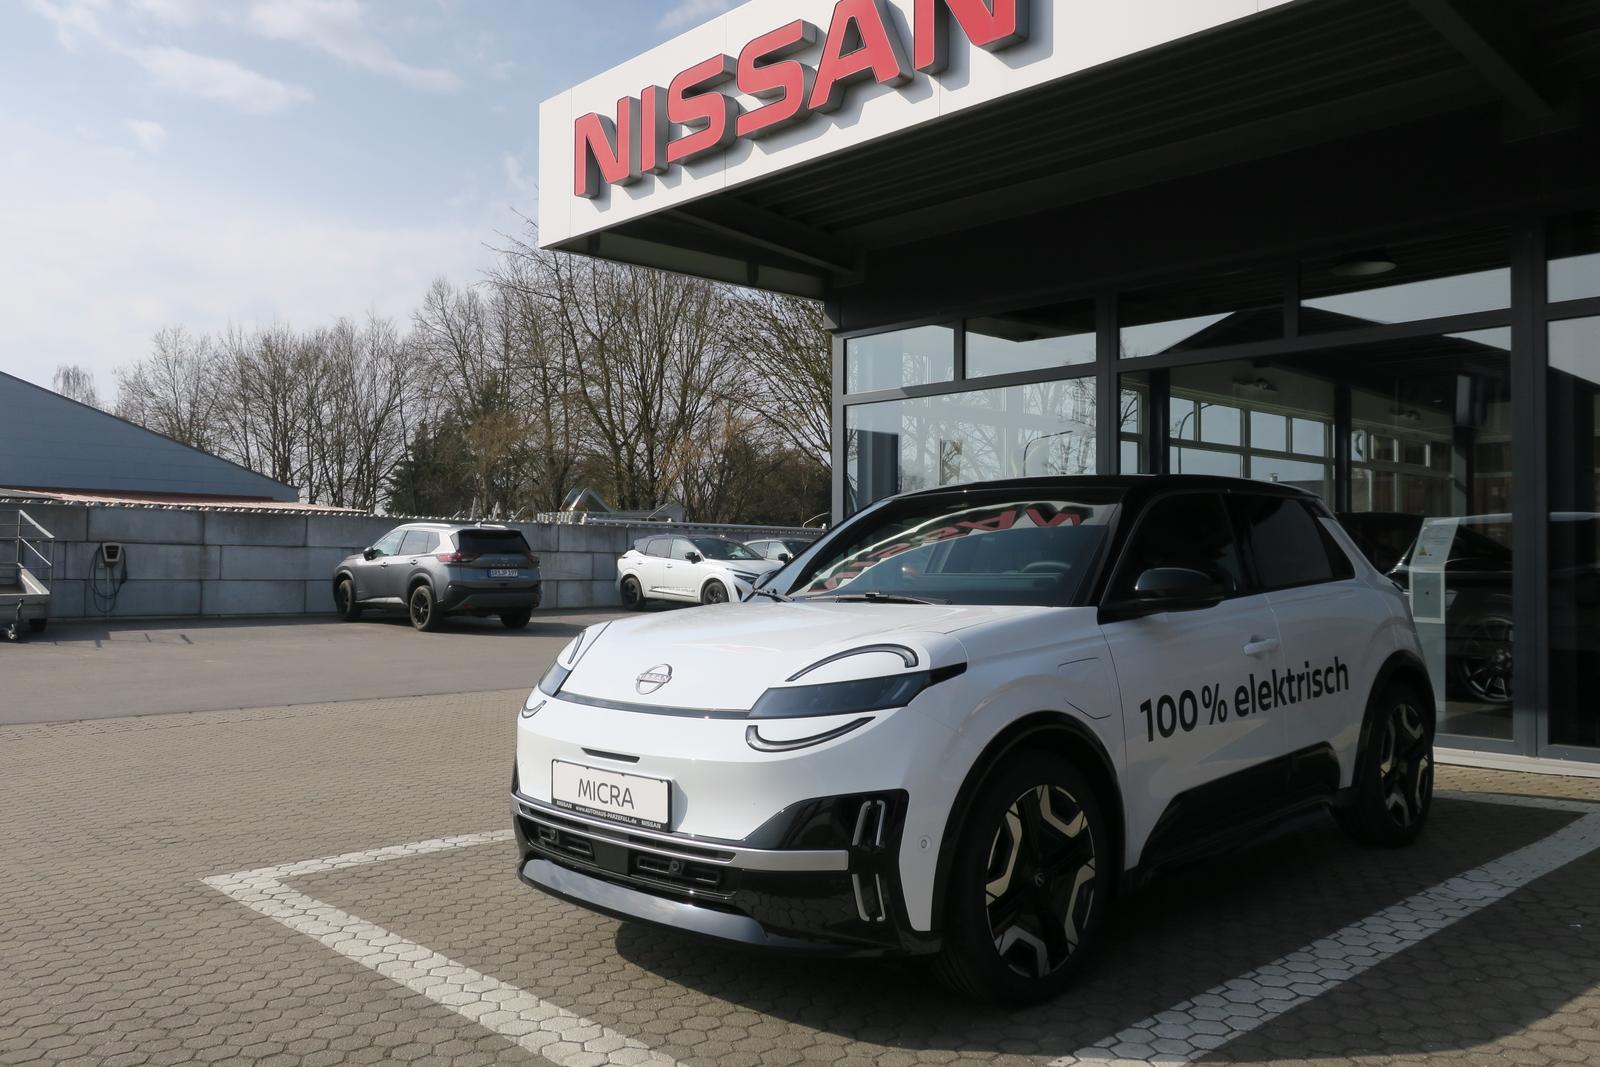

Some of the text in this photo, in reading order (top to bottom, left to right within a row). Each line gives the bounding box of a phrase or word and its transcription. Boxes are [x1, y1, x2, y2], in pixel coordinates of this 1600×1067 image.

[1140, 656, 1350, 742] 100% elektrisch
[578, 778, 635, 810] MICRA
